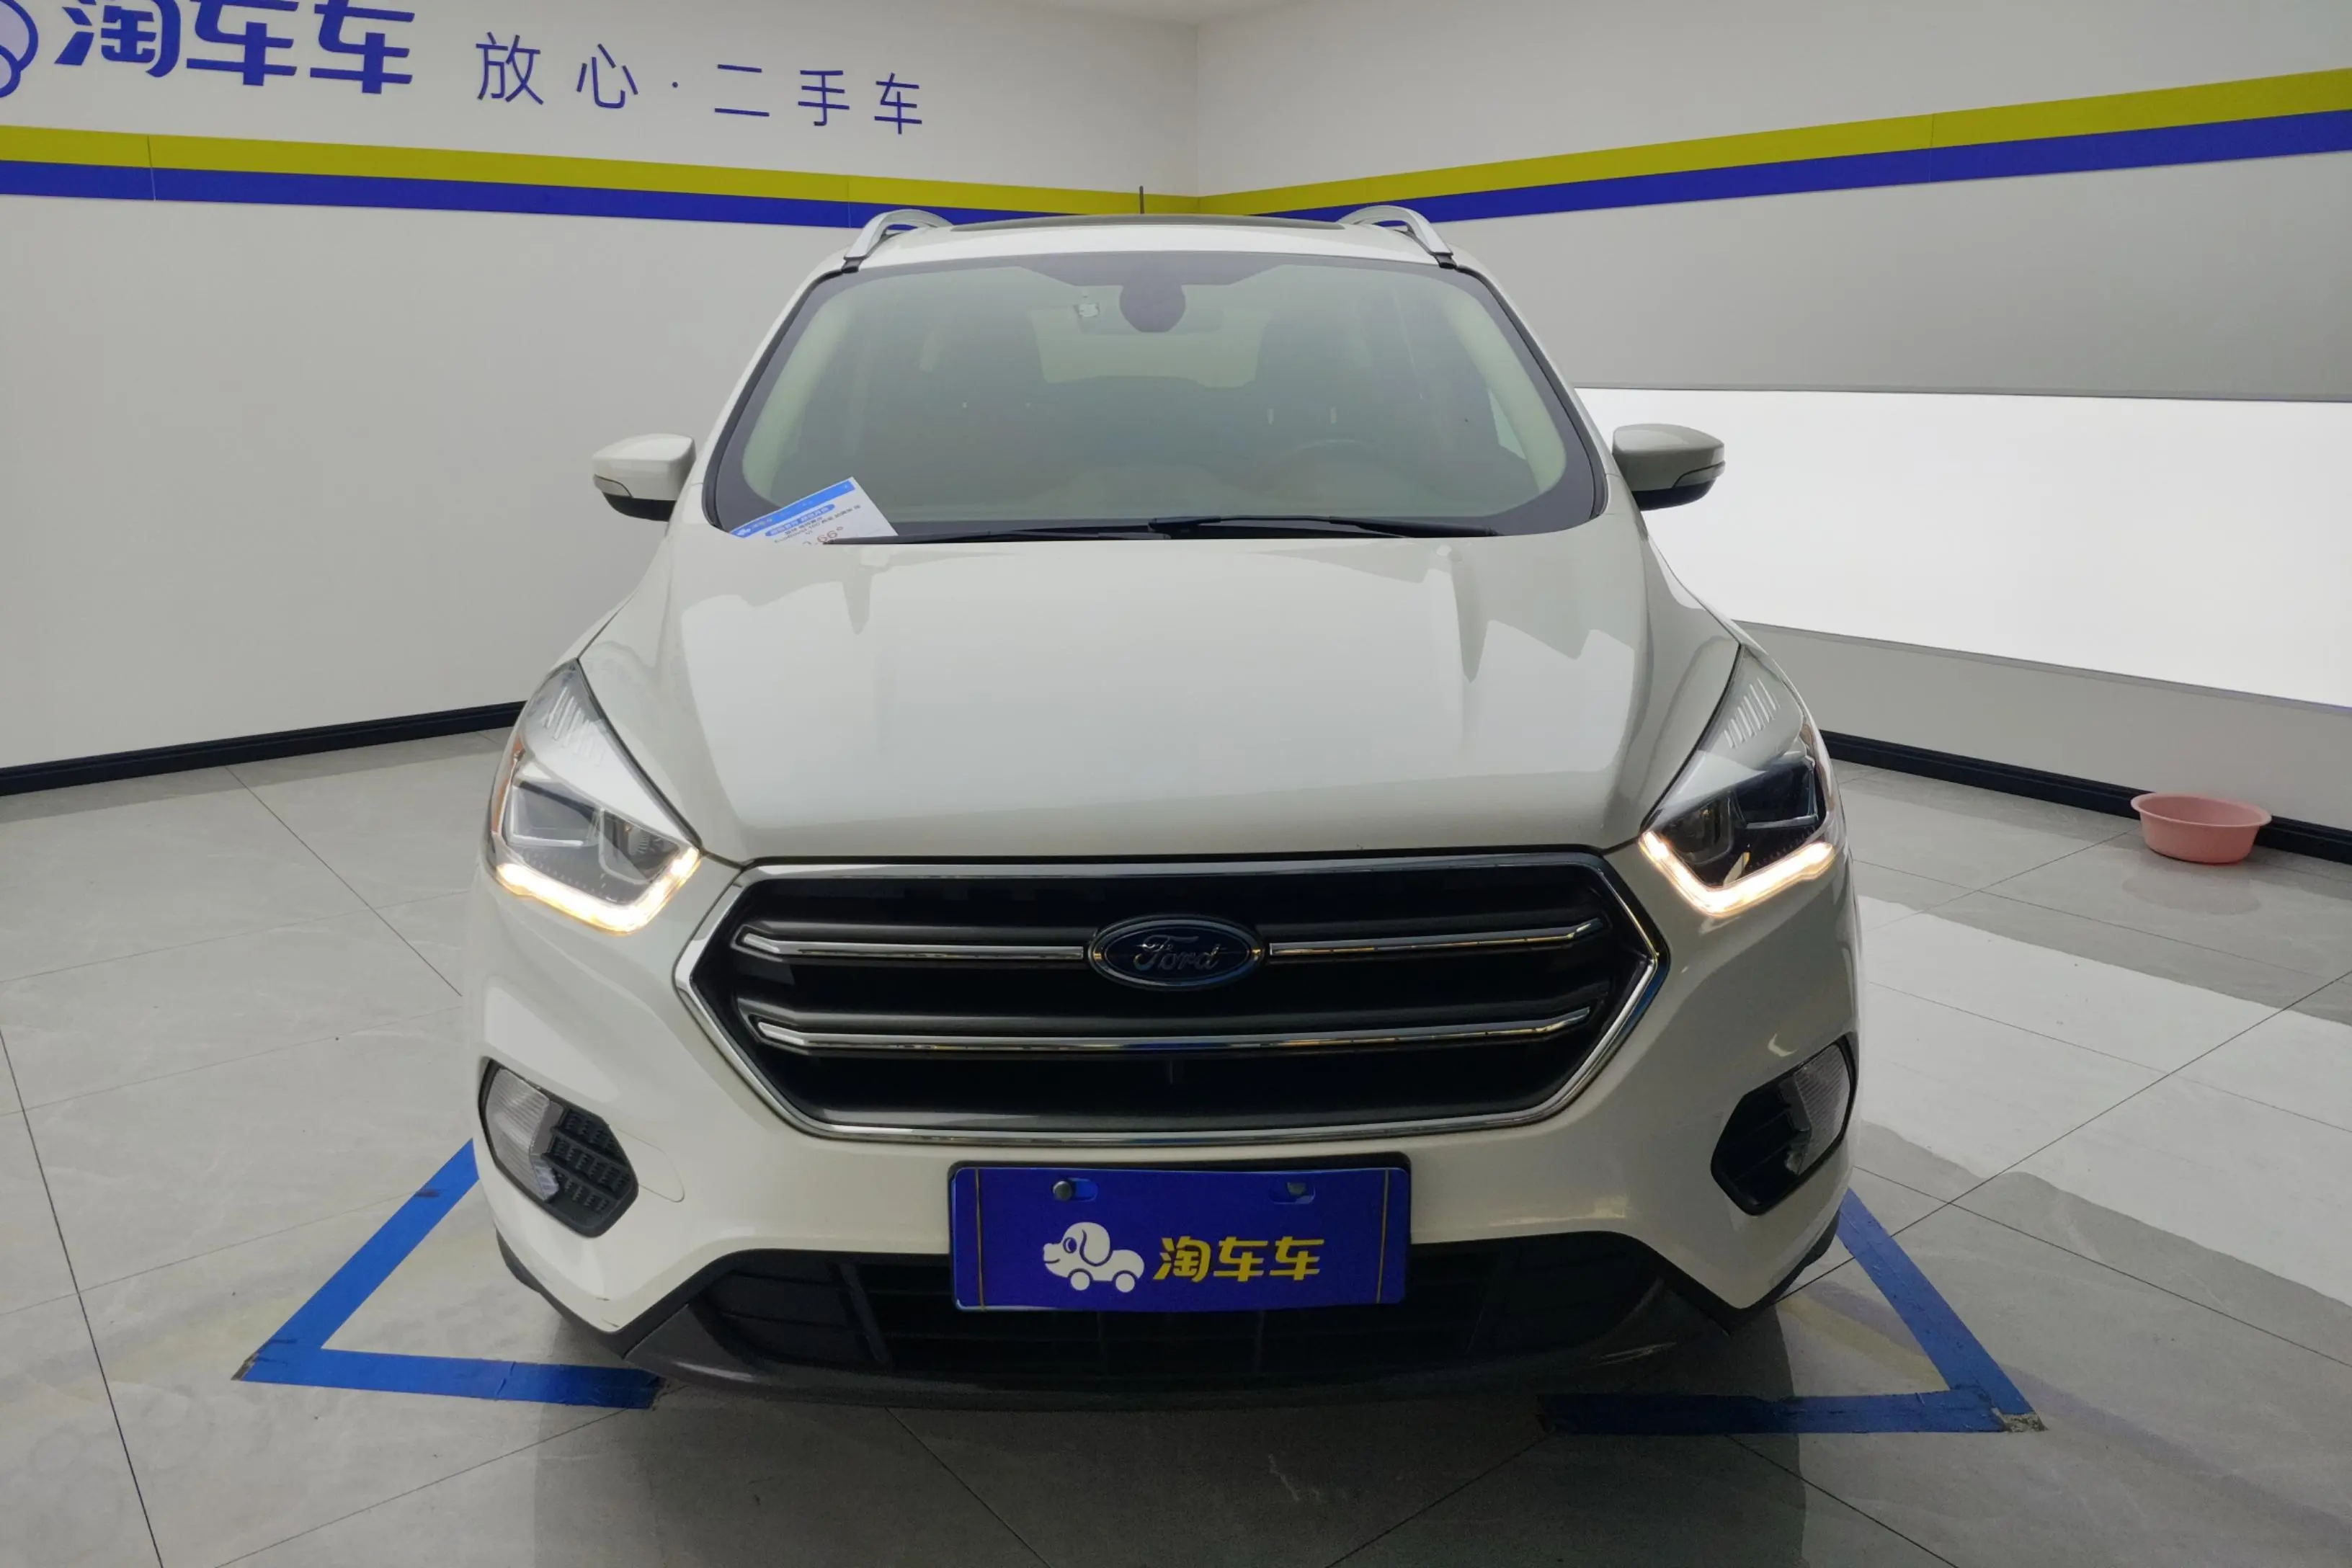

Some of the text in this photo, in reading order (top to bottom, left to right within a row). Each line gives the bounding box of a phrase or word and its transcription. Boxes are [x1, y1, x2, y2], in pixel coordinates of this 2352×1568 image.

[54, 0, 416, 94] 淘车车
[1133, 934, 1228, 971] Ford
[1153, 1236, 1325, 1282] 淘车车
